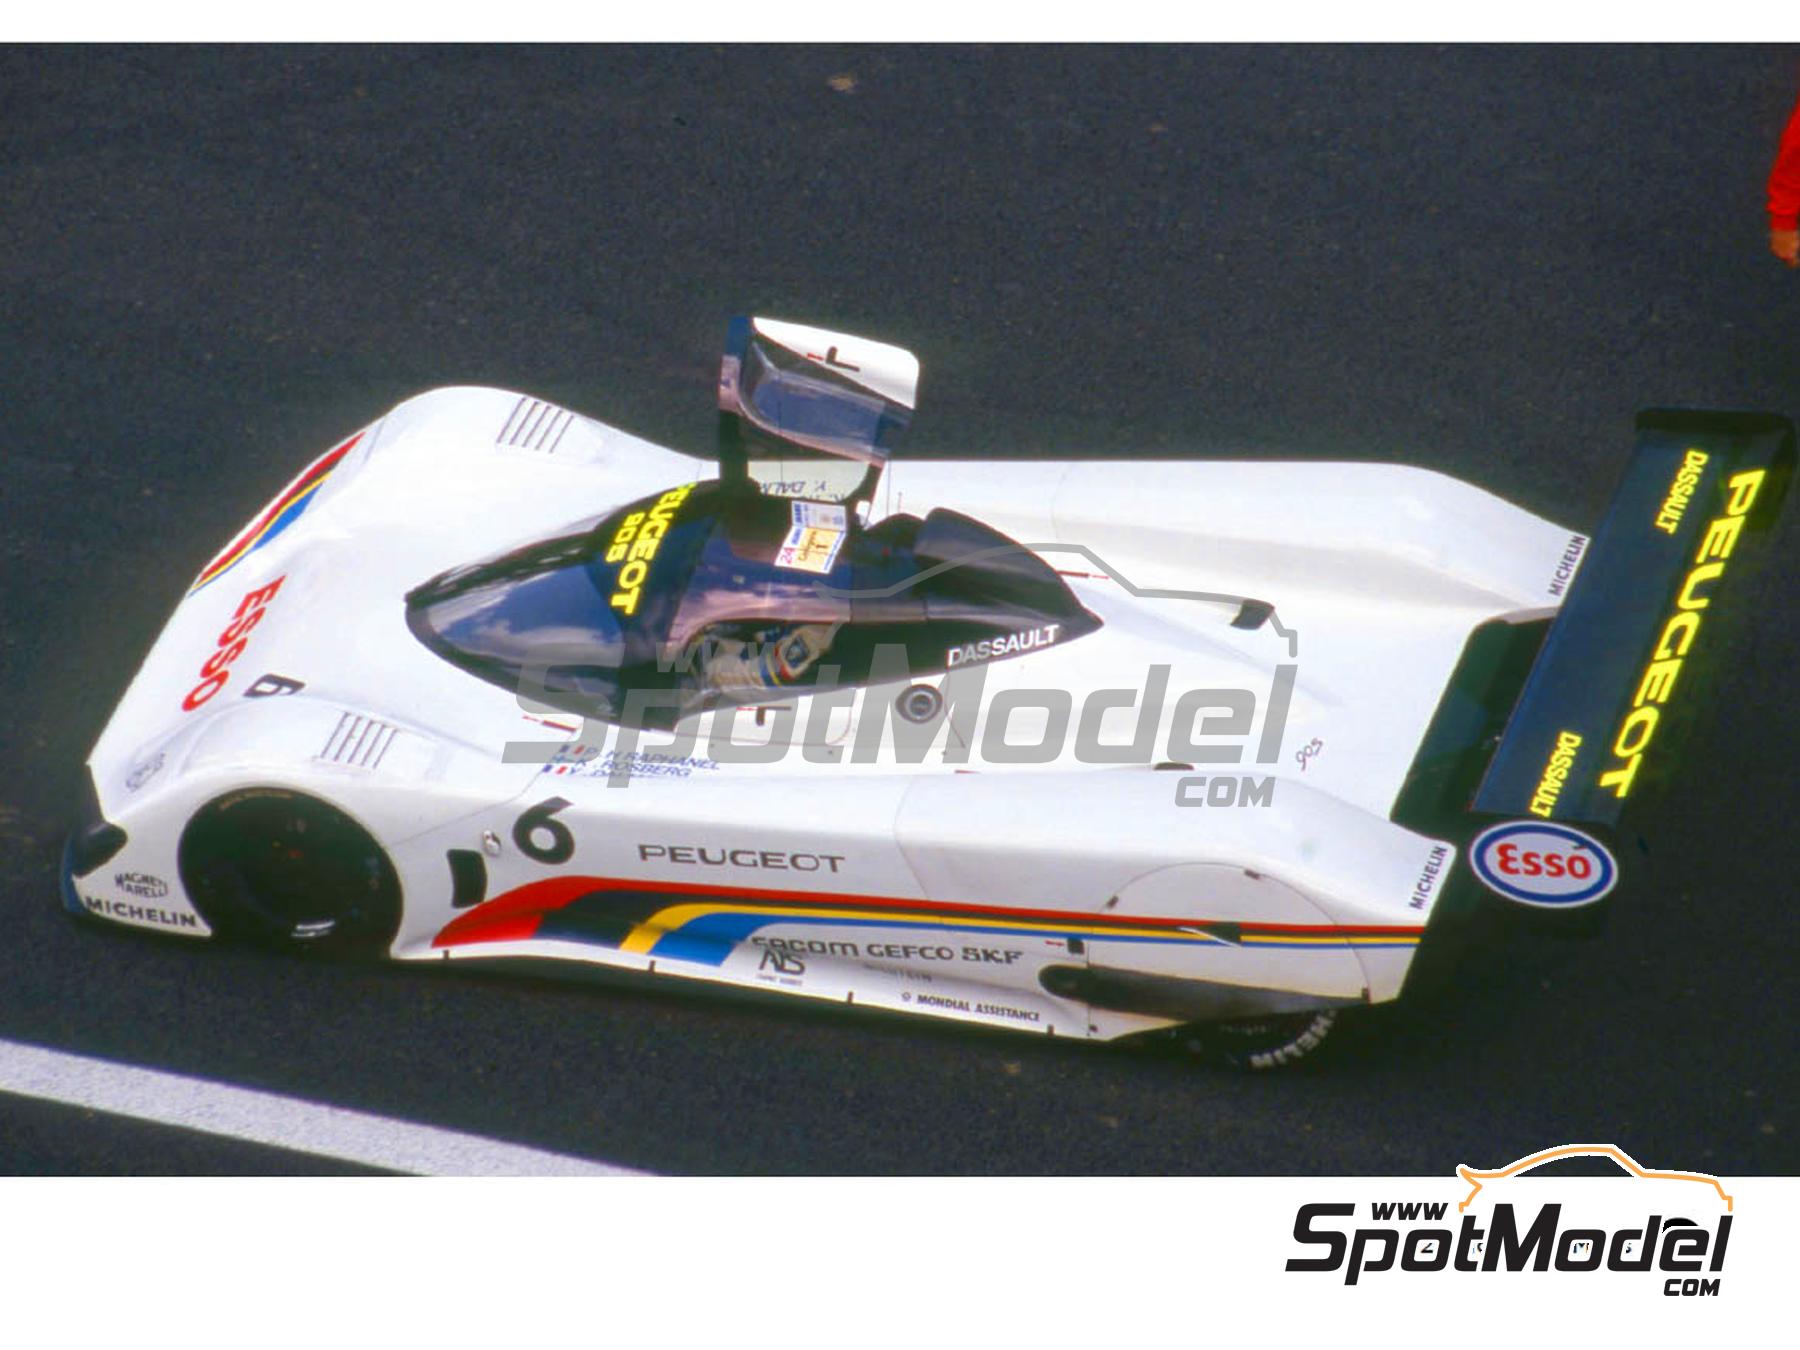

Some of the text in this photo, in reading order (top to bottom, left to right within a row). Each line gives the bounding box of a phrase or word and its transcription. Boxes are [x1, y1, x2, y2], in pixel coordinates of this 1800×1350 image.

[1654, 448, 1709, 534] DASSAULT
[1548, 535, 1586, 597] MICHELIN
[947, 624, 1060, 667] DASSAULT
[1599, 469, 1766, 798] PEUGEOT
[243, 673, 306, 698] 6
[1530, 731, 1583, 817] DASSAULT
[512, 796, 575, 865] 6
[638, 843, 846, 873] PEUGEOT
[1409, 846, 1447, 910] MICHELIN
[85, 896, 197, 927] MICHELIN
[866, 943, 954, 961] GEFCO
[961, 946, 1023, 964] SKF
[916, 993, 1040, 1022] MONDIAL ASSISTANCE
